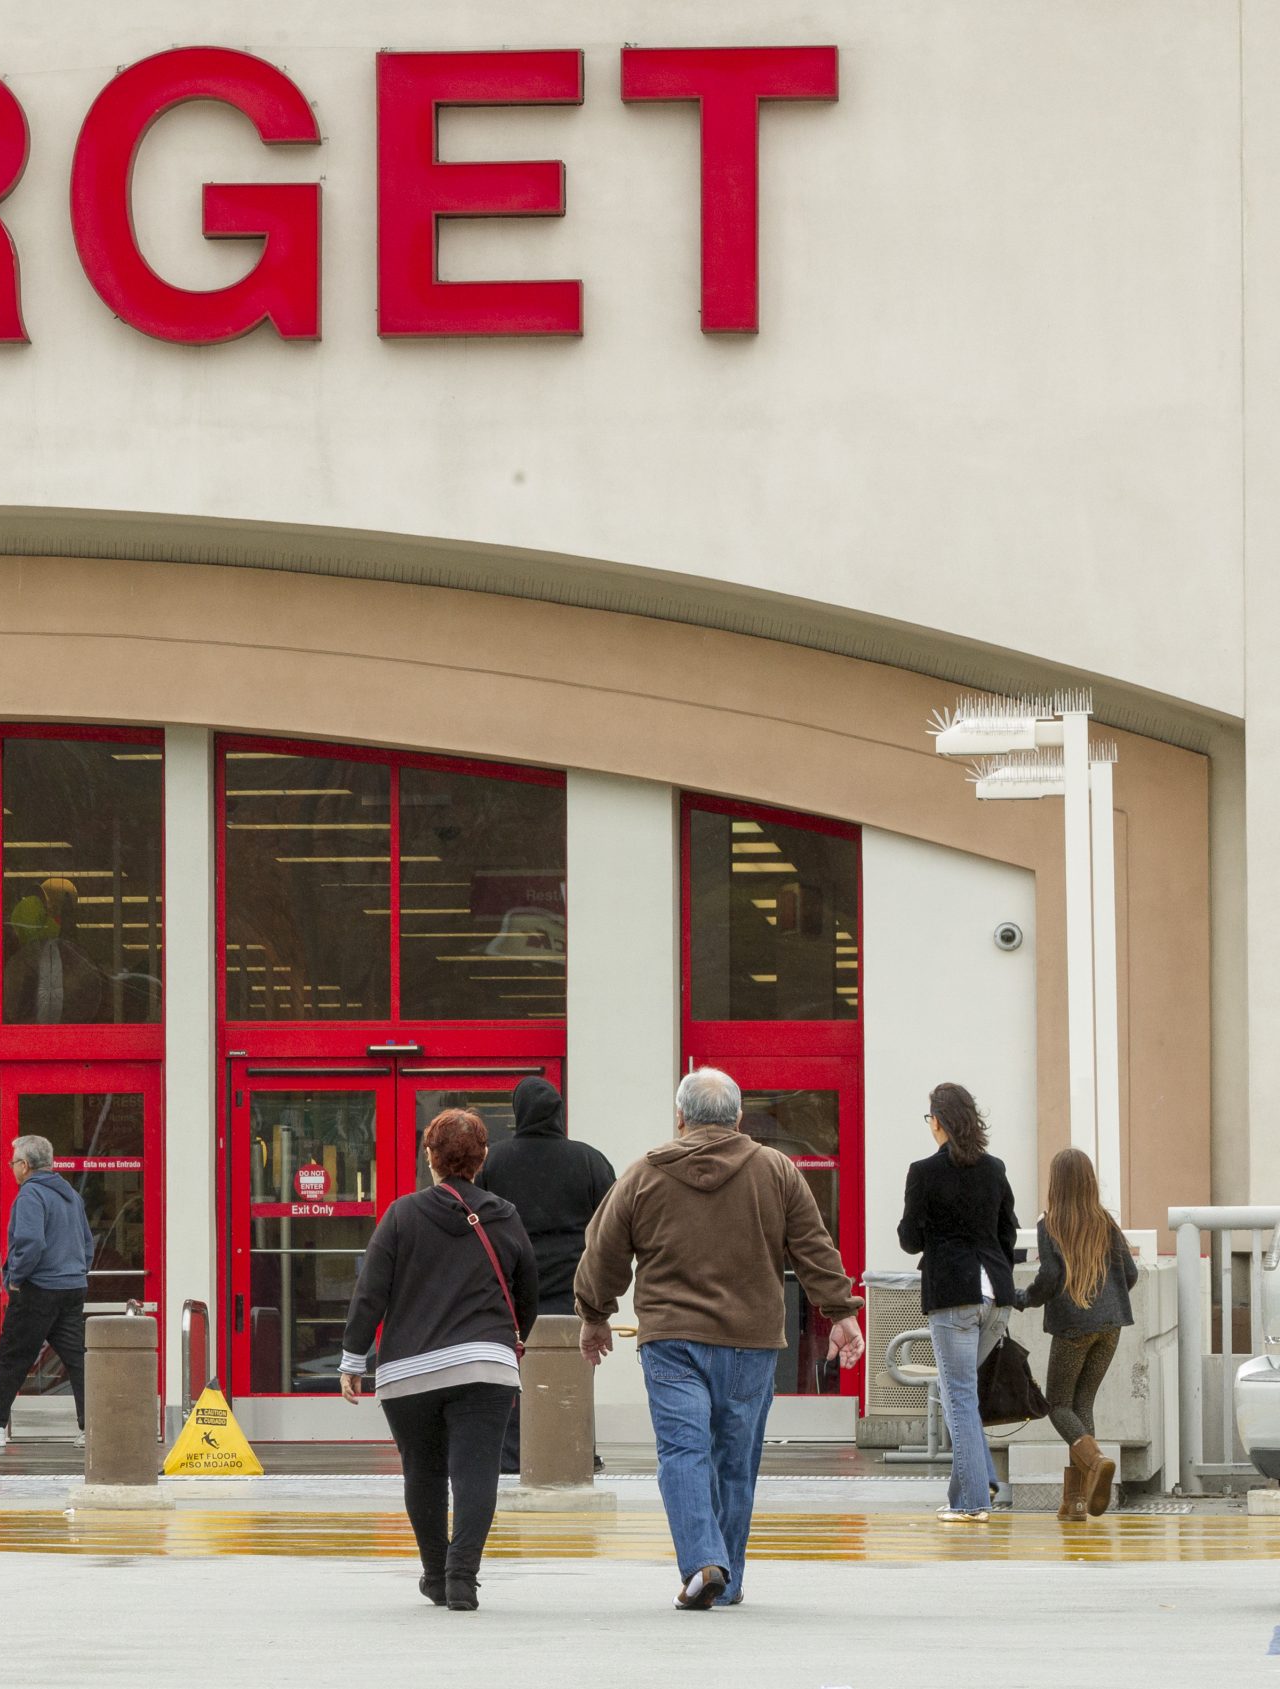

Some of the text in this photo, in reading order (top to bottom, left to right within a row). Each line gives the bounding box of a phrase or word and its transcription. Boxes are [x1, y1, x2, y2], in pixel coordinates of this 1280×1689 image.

[83, 1160, 97, 1168] Esta
[116, 1160, 141, 1168] Entrada
[797, 1159, 835, 1167] únicamente
[292, 1204, 334, 1216] Exit Only
[203, 1417, 226, 1425] CUIDADO
[204, 1460, 242, 1468] MOJADO
